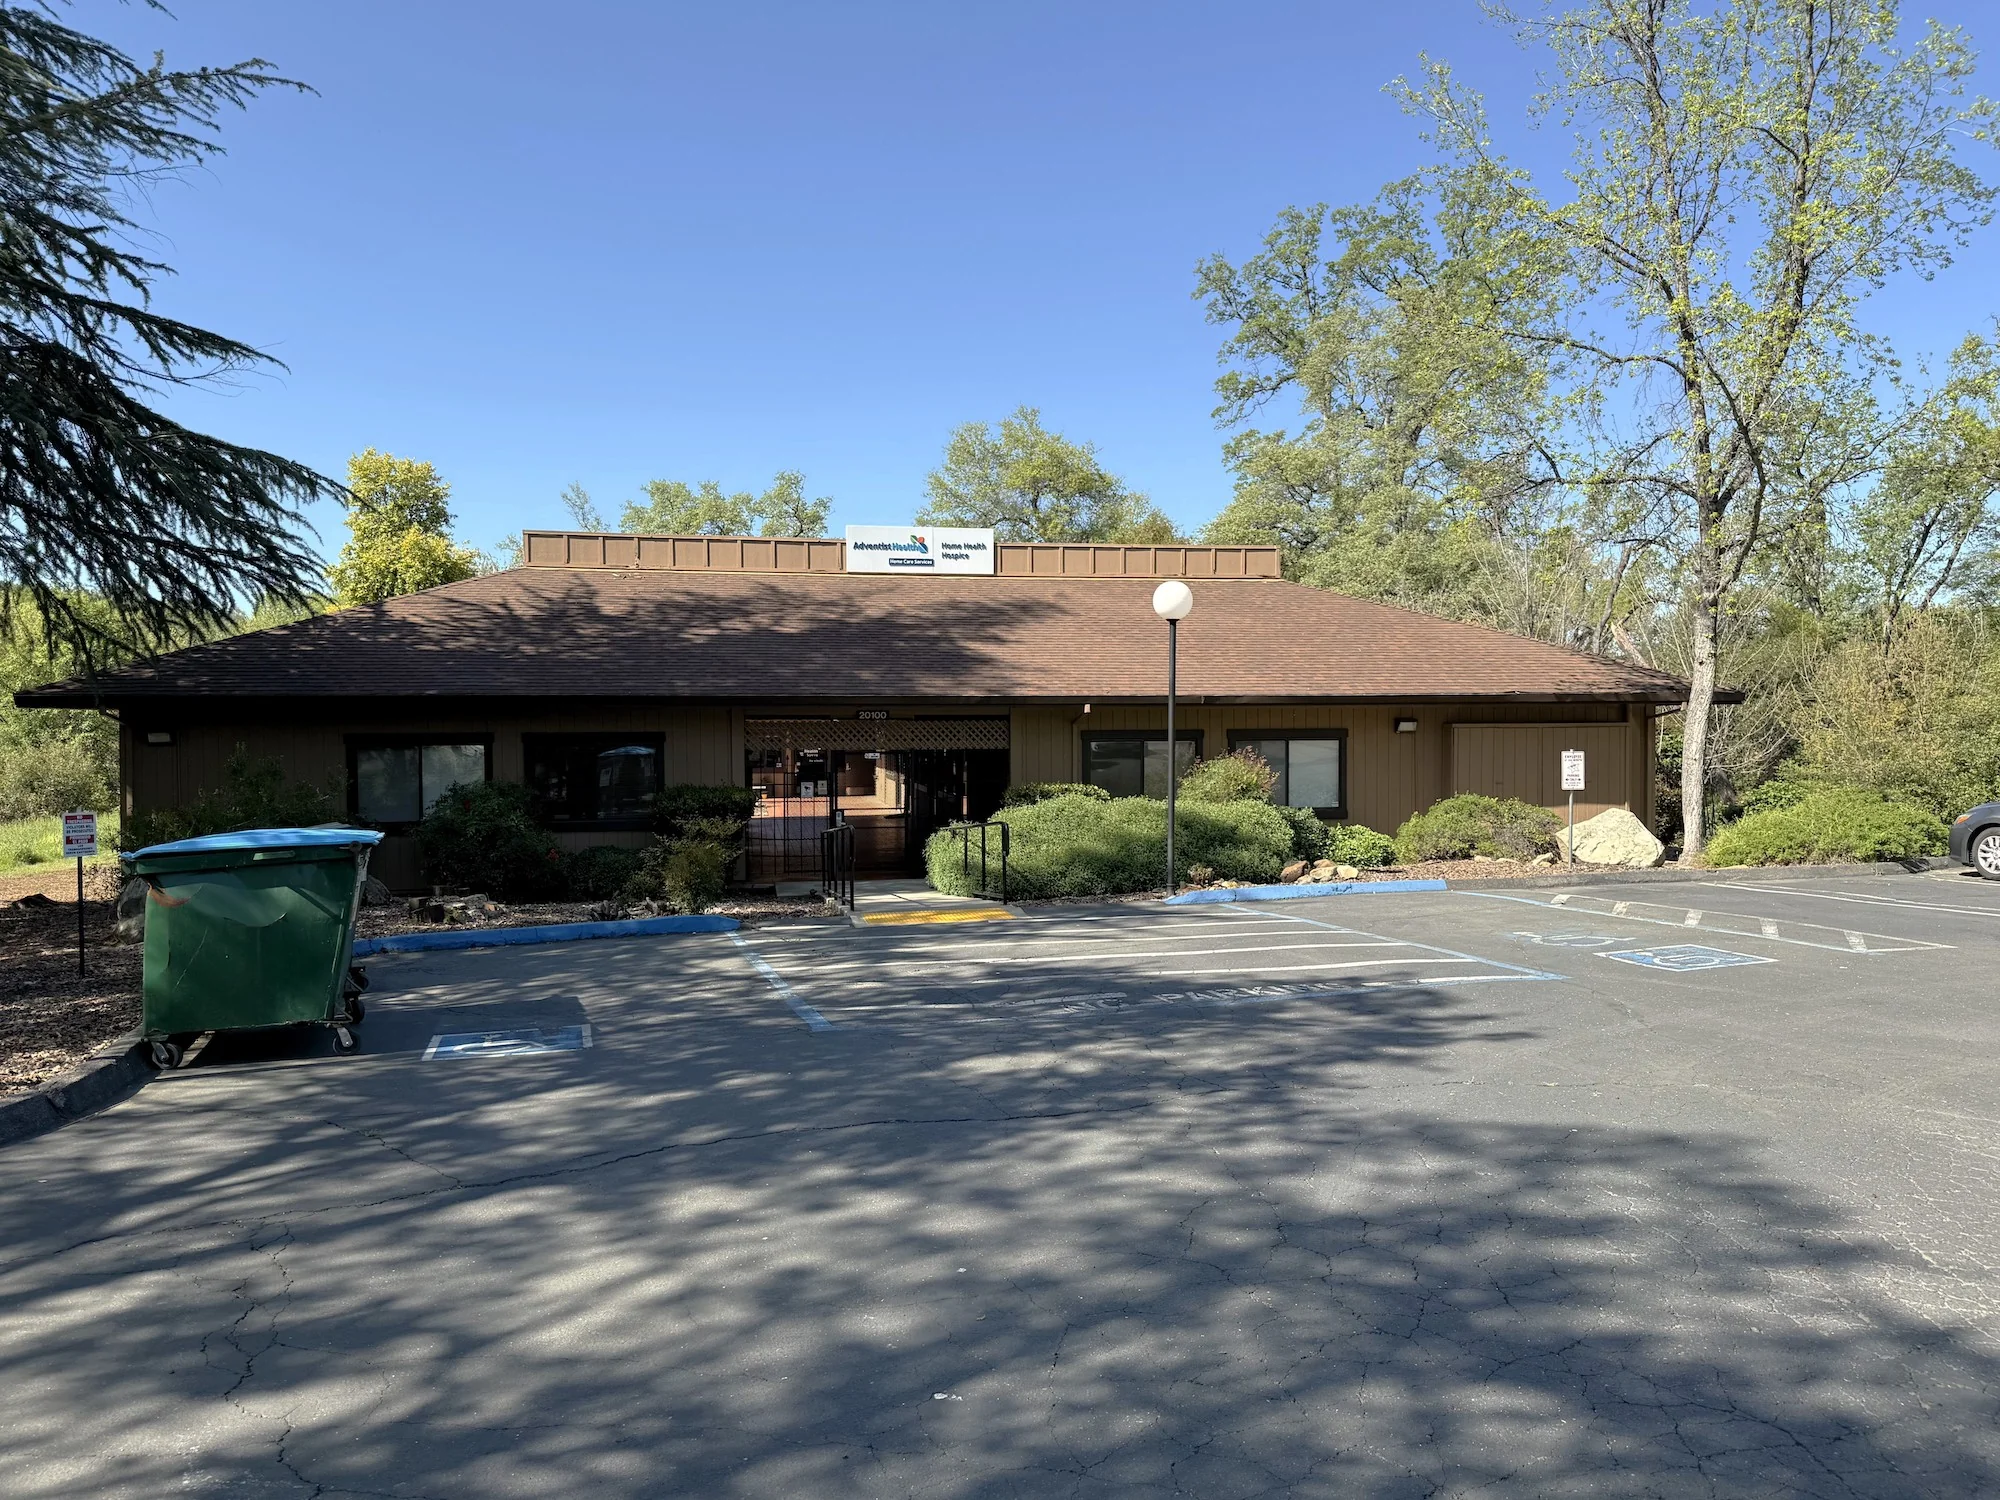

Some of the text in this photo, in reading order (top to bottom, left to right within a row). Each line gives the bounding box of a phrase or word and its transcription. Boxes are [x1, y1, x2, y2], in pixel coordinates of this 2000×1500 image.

[853, 541, 918, 552] Adventist Health
[941, 542, 987, 551] Home Health
[941, 552, 970, 561] Hospice
[858, 711, 887, 720] 20100
[1152, 982, 1352, 1004] PARKING
